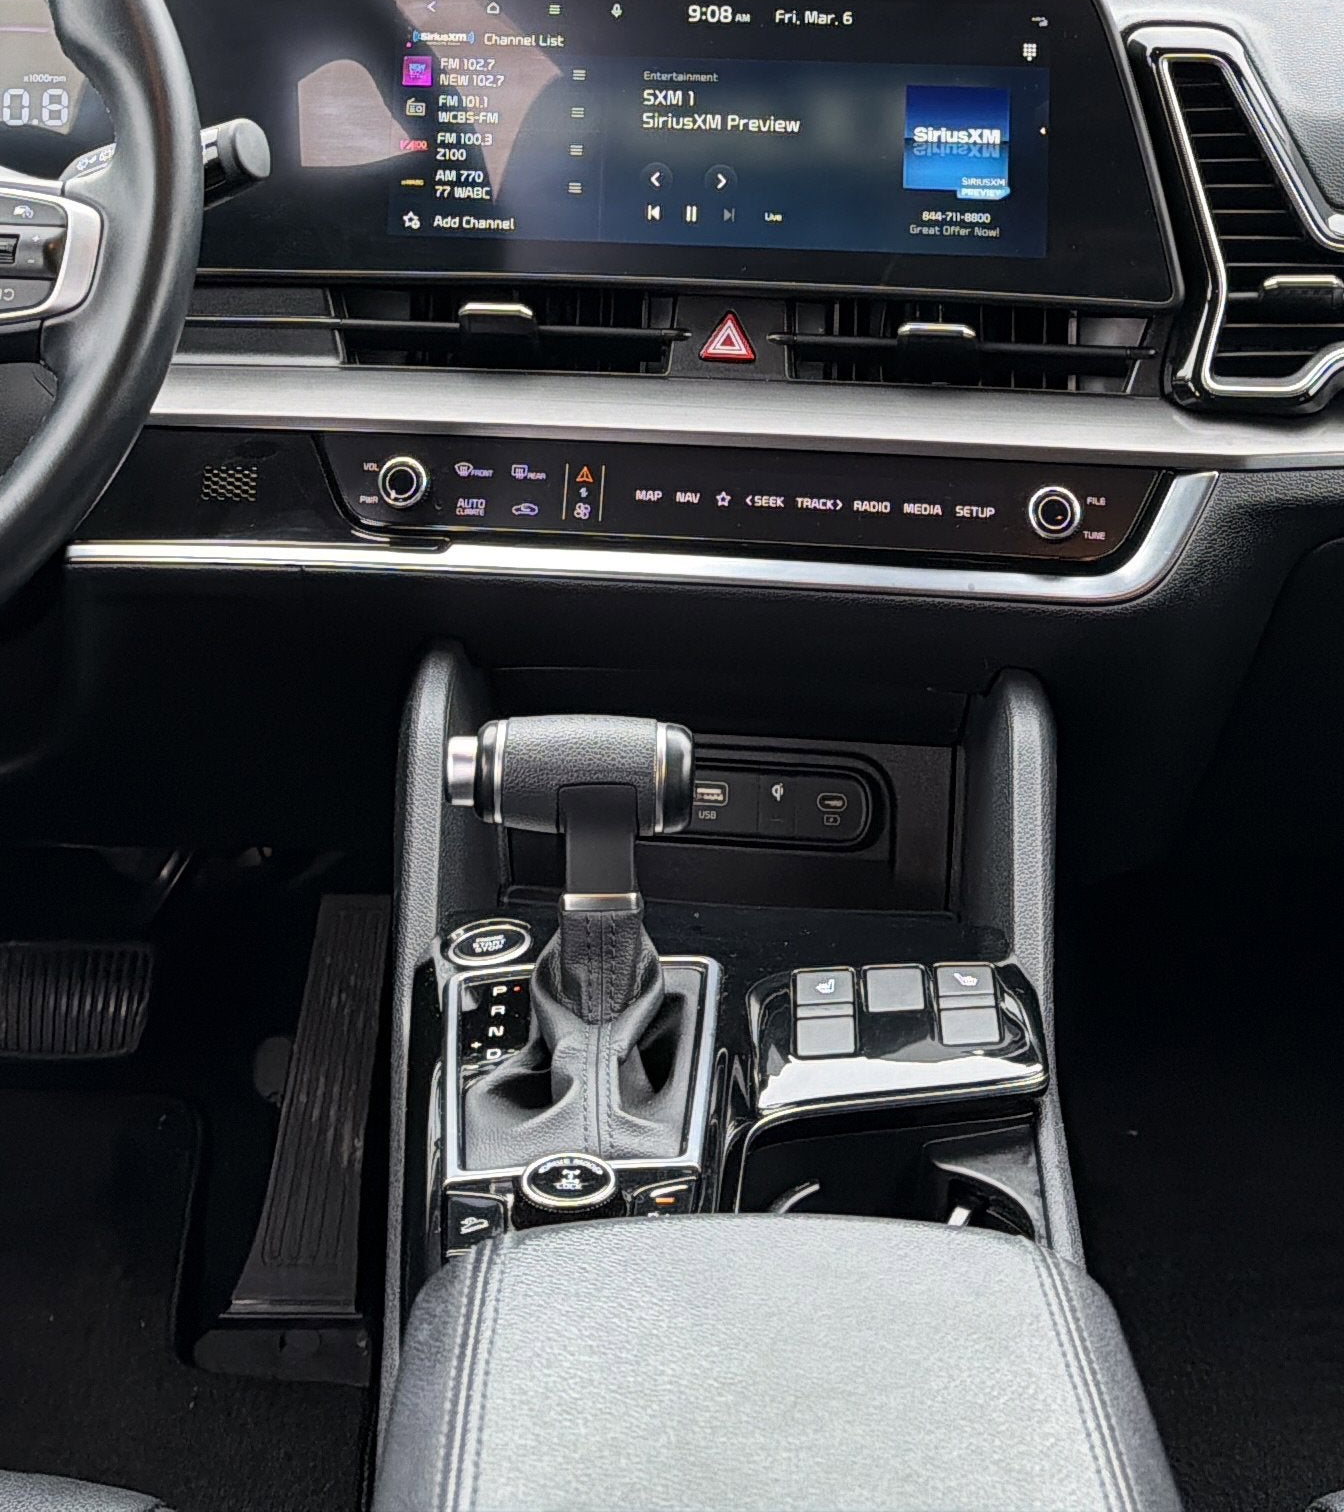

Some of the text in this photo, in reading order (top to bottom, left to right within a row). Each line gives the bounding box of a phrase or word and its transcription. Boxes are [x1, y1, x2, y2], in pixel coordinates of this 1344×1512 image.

[687, 5, 751, 23] 9:08 AM
[775, 9, 853, 26] Fri. Mar. 6
[484, 32, 565, 47] Channel List
[440, 57, 496, 71] FM 102.7
[439, 74, 469, 86] NEW
[472, 75, 505, 88] 102.7
[643, 71, 719, 83] Entertainment
[438, 95, 488, 108] FM 101.1
[642, 91, 696, 107] SXM 1
[2, 87, 70, 127] 0.8
[438, 111, 499, 124] WCBS-FM
[642, 113, 801, 133] SiriusXM Preview
[437, 132, 493, 145] FM 100.3
[912, 126, 1001, 146] SiriusXM
[435, 148, 467, 161] Z100
[434, 169, 484, 183] AM 770
[961, 177, 1006, 186] SIRIUSXM
[434, 185, 491, 200] 77 WABC
[433, 215, 515, 230] Add Channel
[763, 212, 783, 223] Live
[909, 224, 1001, 239] Great Offer Now!
[363, 462, 380, 472] VOL
[470, 468, 494, 478] FRONT
[527, 471, 547, 480] REAR
[359, 495, 379, 504] PWR
[635, 489, 662, 502] MAP
[675, 491, 701, 504] NAV
[1086, 497, 1106, 506] FILE
[456, 497, 486, 509] AUTO
[853, 500, 891, 513] RADIO
[903, 502, 943, 516] MEDIA
[955, 504, 996, 518] SETUP
[1083, 531, 1106, 540] TUNE
[698, 810, 717, 820] USB
[492, 985, 507, 997] P
[488, 1025, 504, 1037] N
[486, 1048, 502, 1060] D
